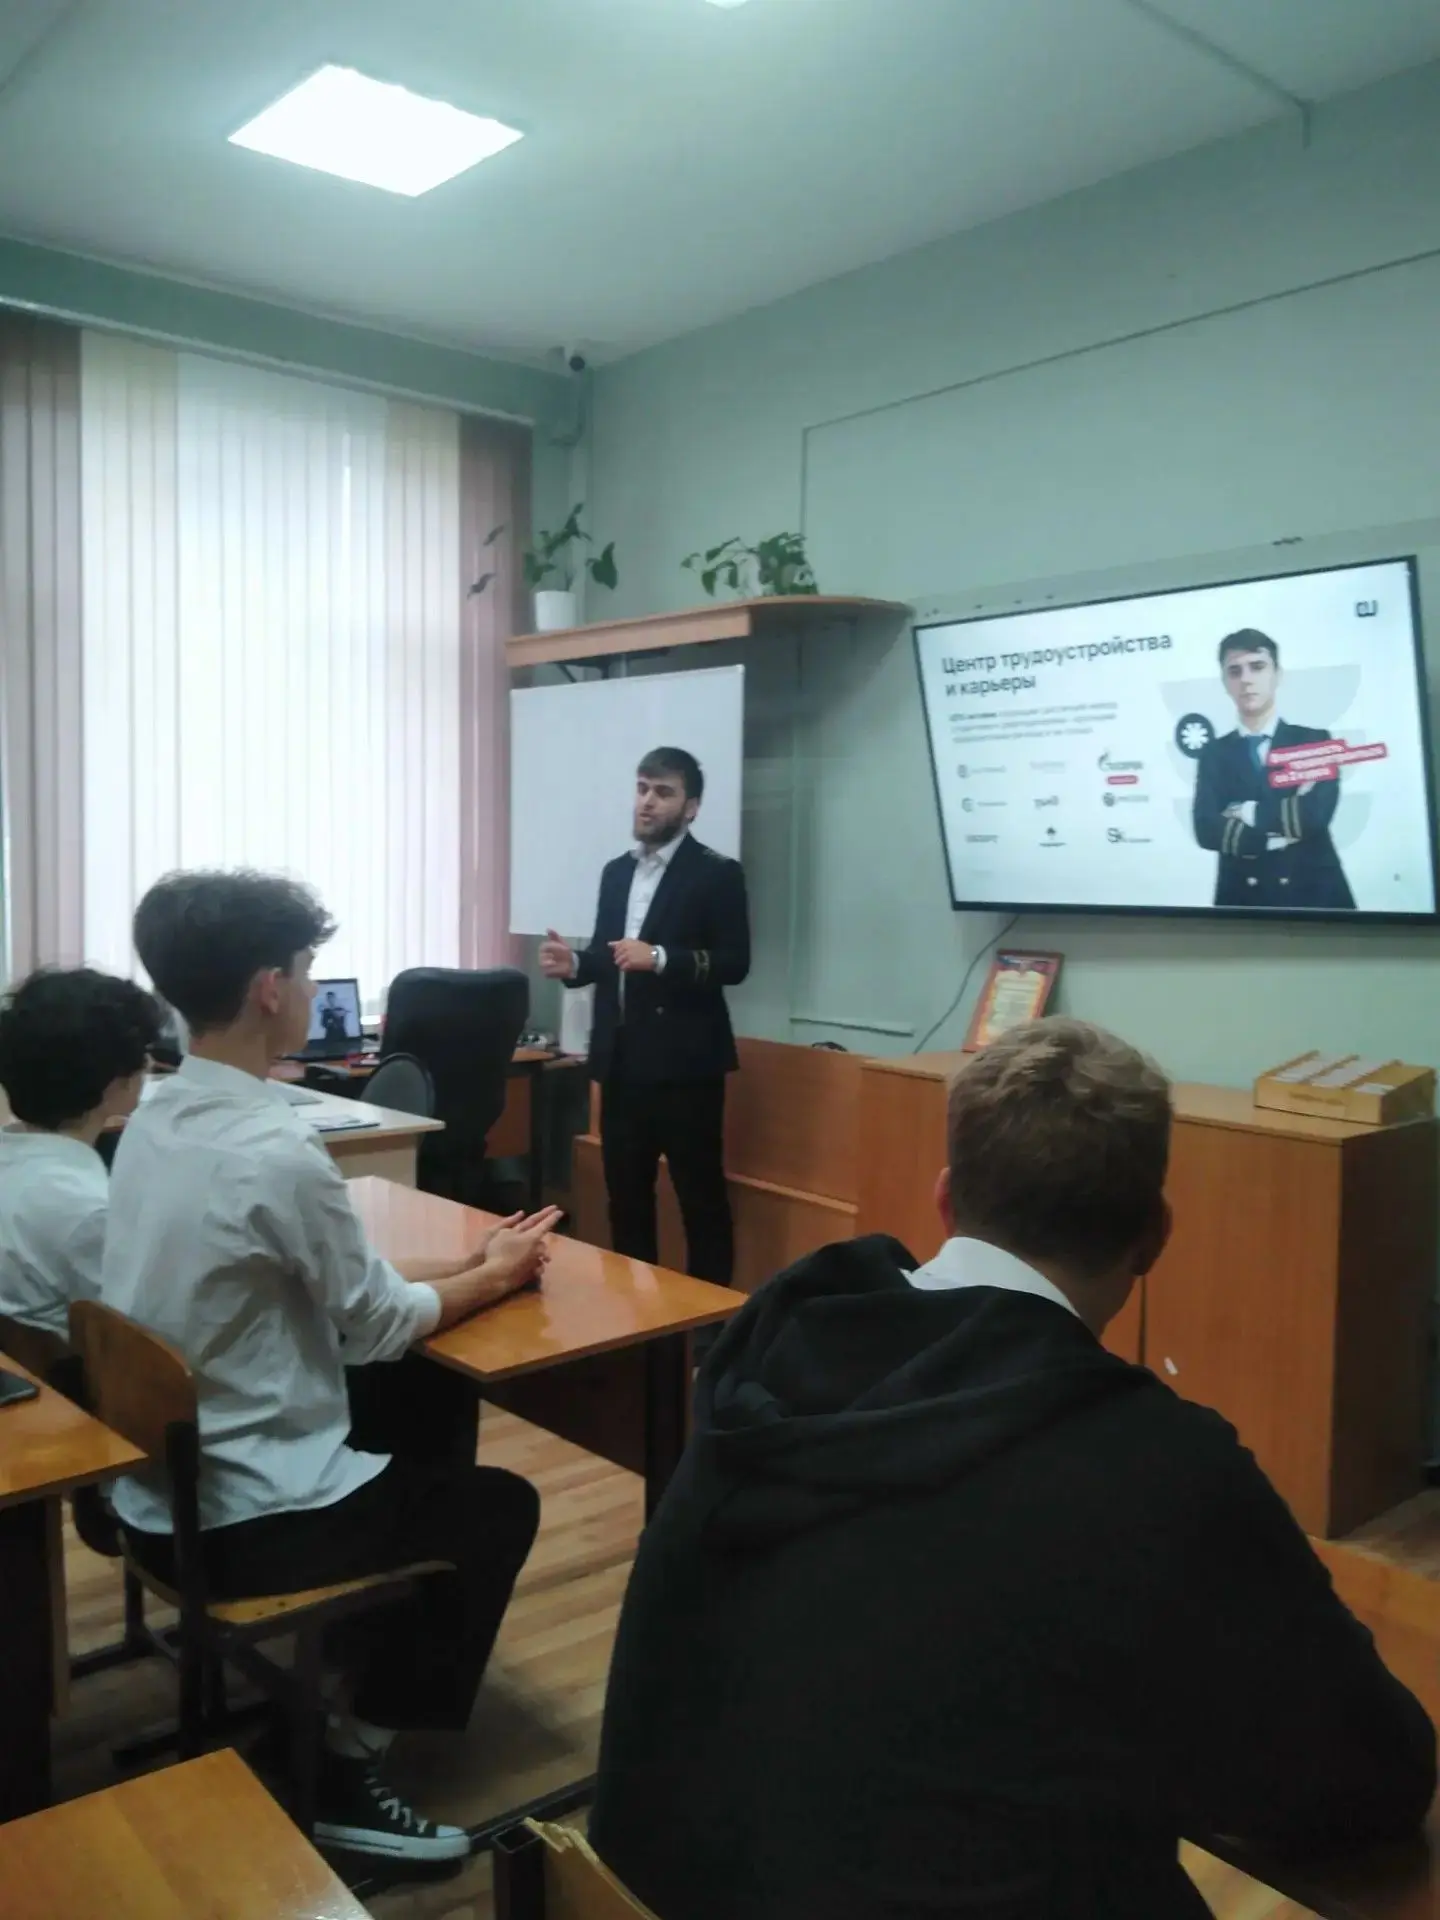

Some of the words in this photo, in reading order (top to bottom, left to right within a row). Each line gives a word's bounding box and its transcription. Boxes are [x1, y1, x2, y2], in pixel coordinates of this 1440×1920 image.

[942, 655, 996, 675] Центр
[1001, 634, 1172, 670] трудоустройства
[946, 684, 957, 697] и
[961, 676, 1036, 697] карьеры
